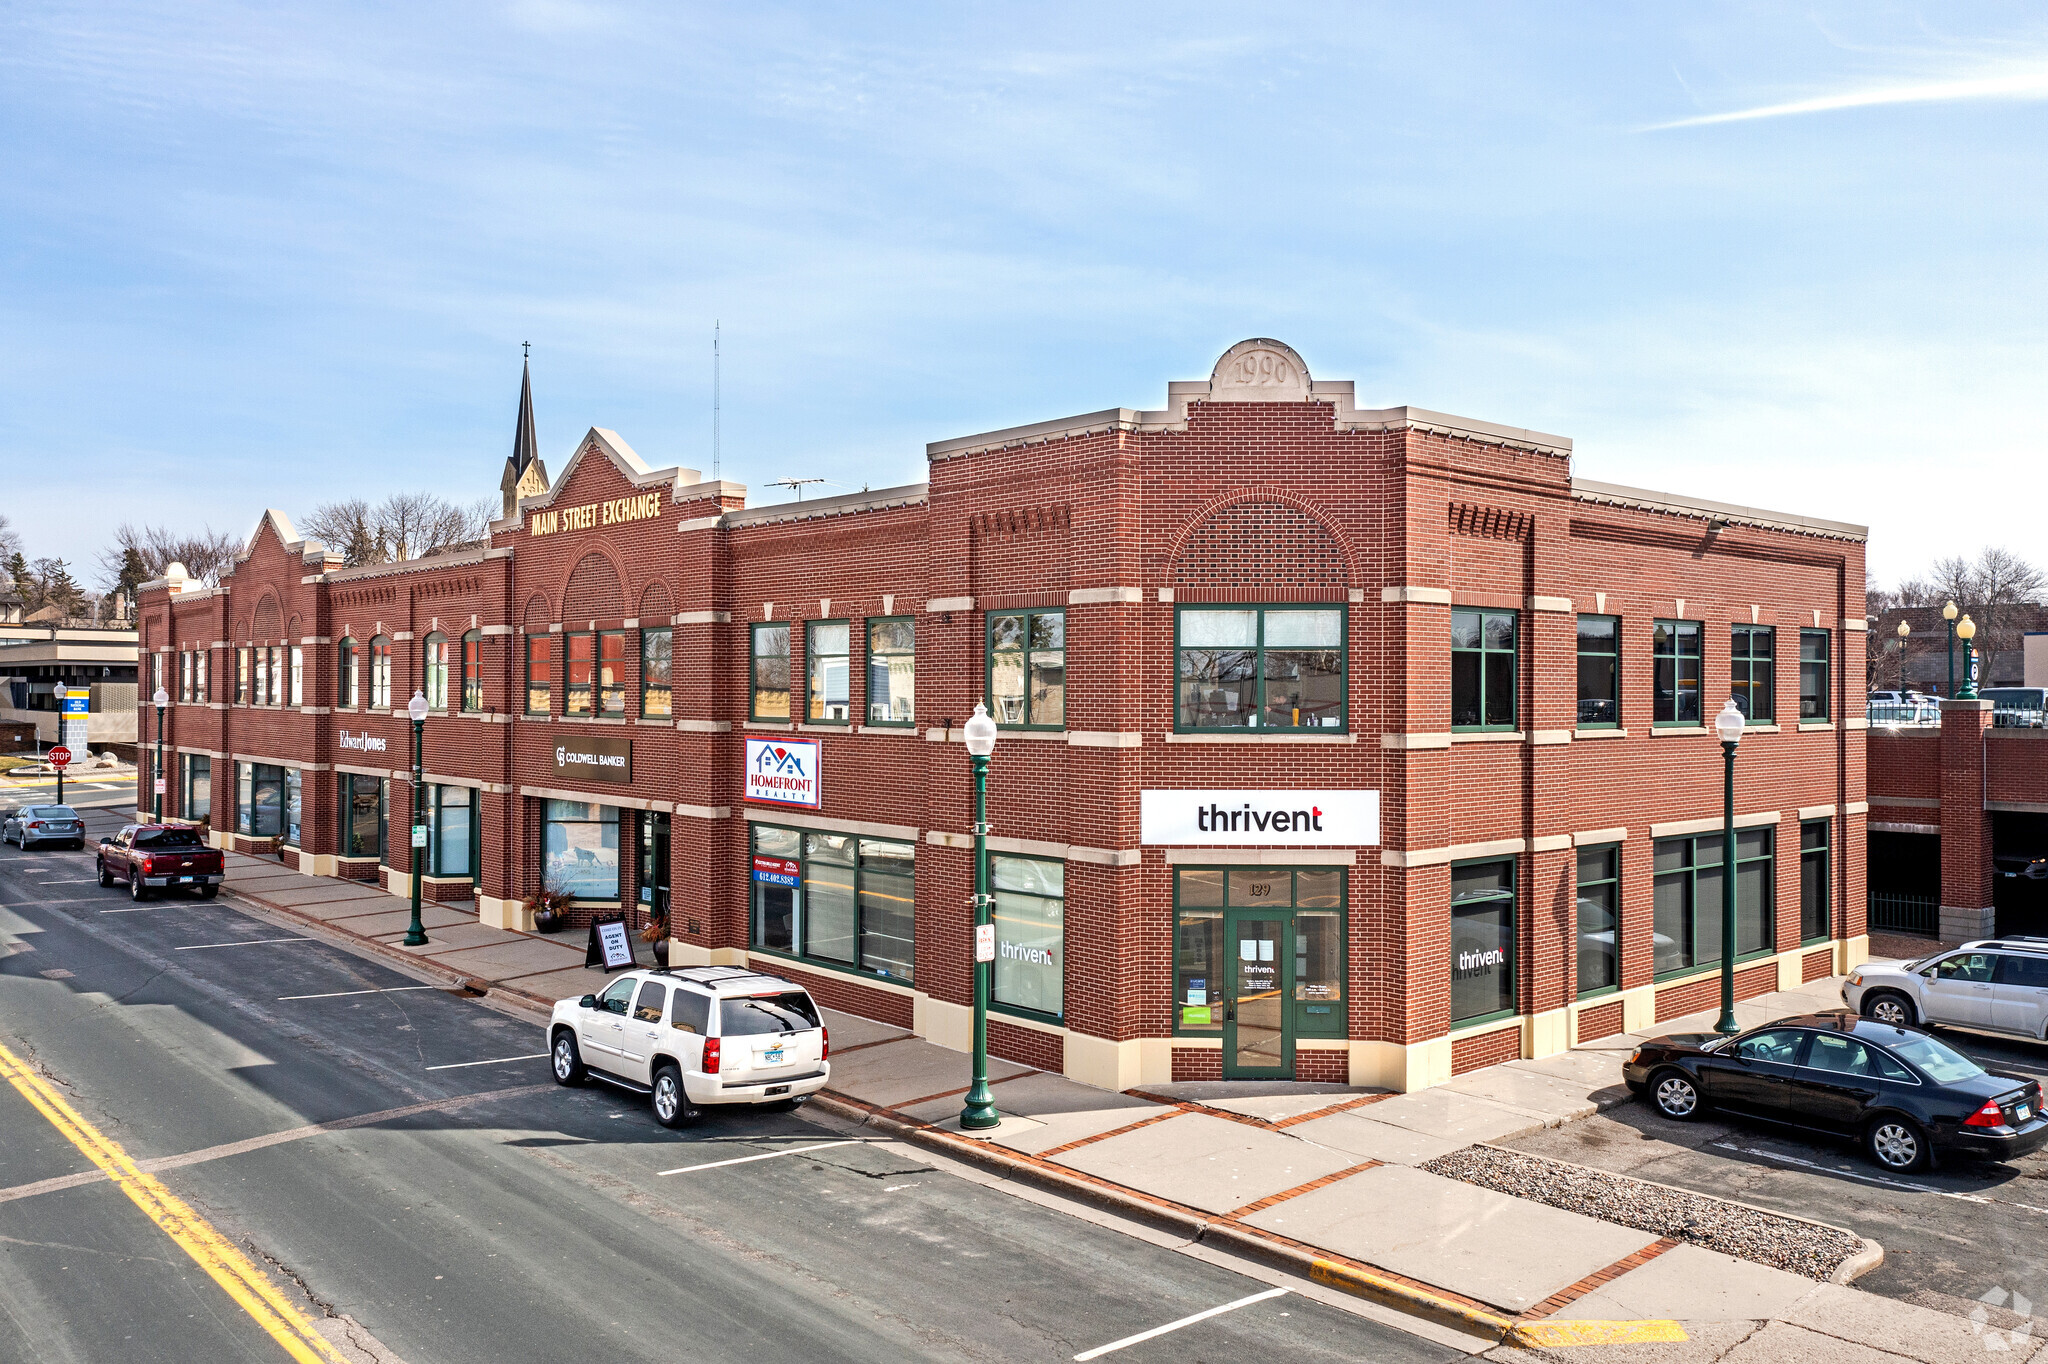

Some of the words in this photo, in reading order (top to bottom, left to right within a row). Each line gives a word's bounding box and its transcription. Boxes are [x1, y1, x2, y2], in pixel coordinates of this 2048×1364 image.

[1236, 356, 1287, 383] 1990
[532, 511, 558, 536] MAIN
[563, 504, 598, 532] STREET
[602, 492, 661, 525] EXCHANGE
[340, 730, 364, 749] Edward
[364, 731, 387, 752] Jones
[566, 752, 599, 765] COLDWELL
[599, 754, 626, 768] BANKER
[750, 774, 812, 792] HOMEFRONT
[756, 789, 806, 800] REALTY
[1198, 803, 1323, 832] thrivent
[1248, 883, 1271, 897] 129
[1001, 940, 1052, 966] thrivent
[1460, 946, 1503, 970] thrivent
